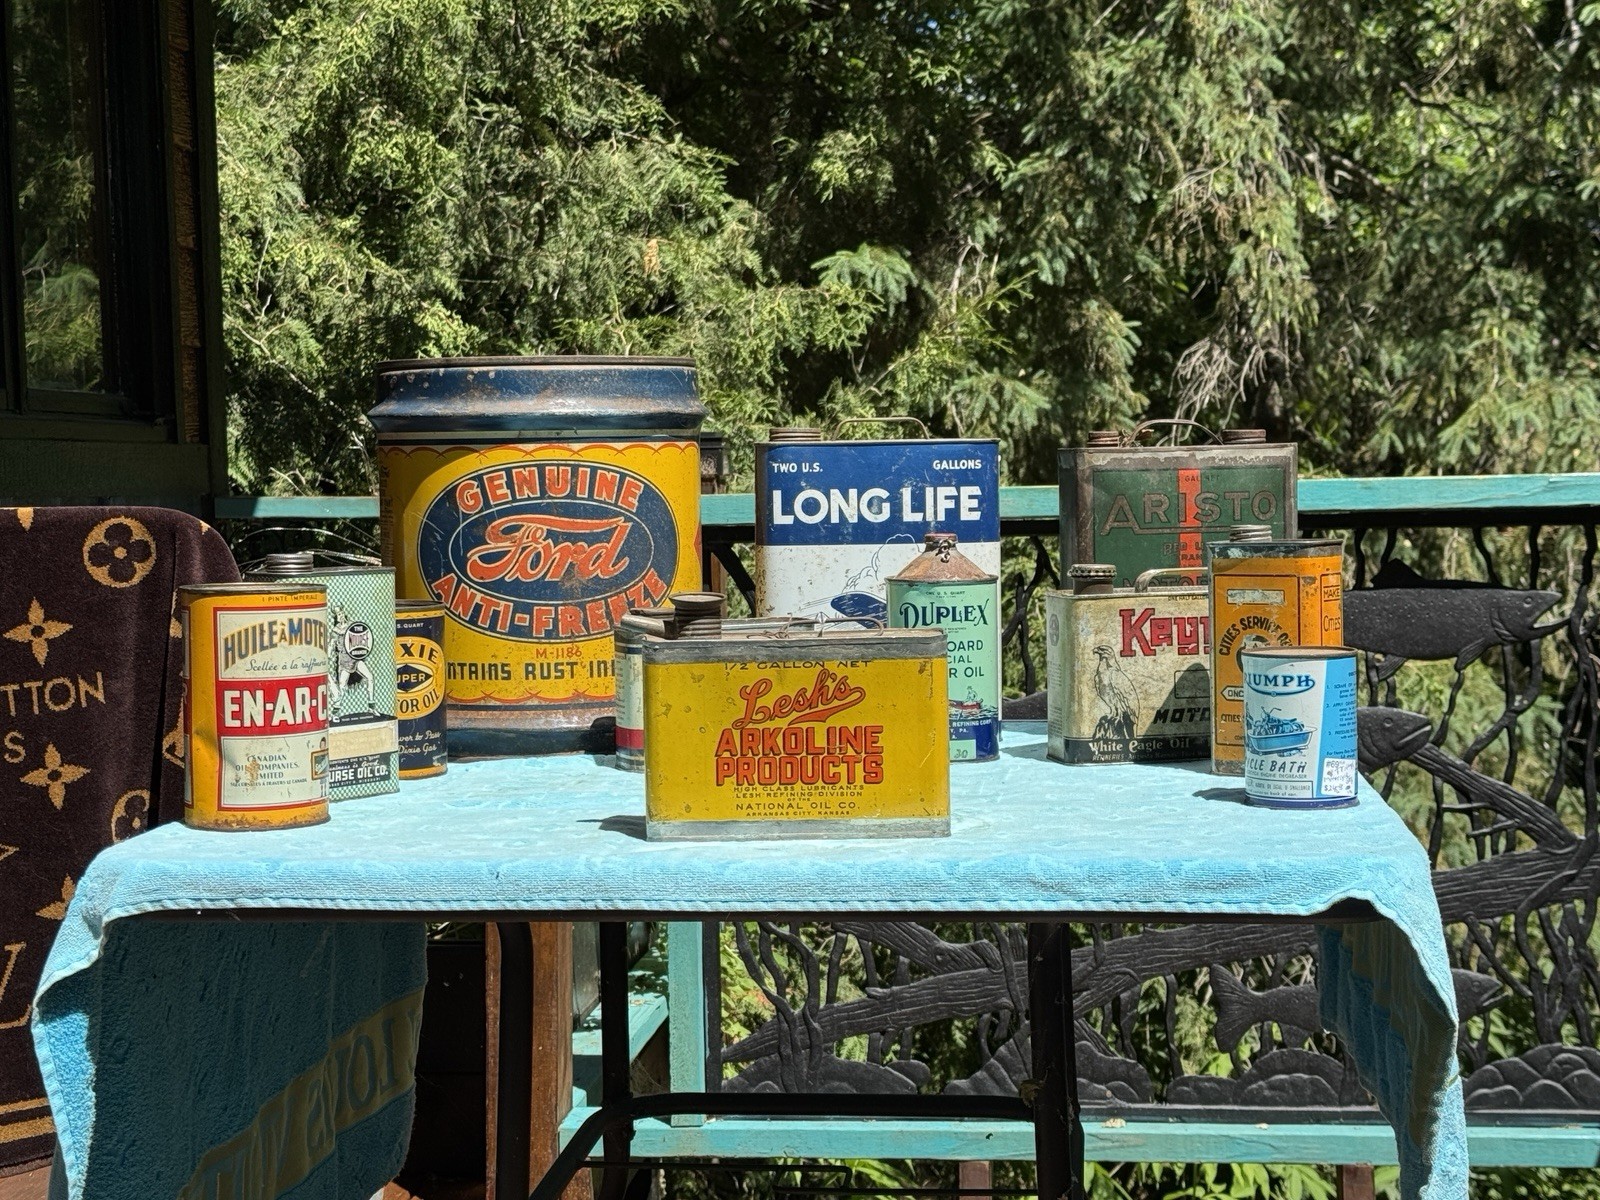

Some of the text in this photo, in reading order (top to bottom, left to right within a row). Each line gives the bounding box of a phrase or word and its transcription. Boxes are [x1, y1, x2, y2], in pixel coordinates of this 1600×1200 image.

[772, 462, 823, 473] TWO U.S.
[932, 459, 982, 470] GALLONS
[456, 465, 644, 515] GENUINE
[772, 486, 982, 525] LONG LIFE
[1100, 489, 1277, 535] ARISTO
[466, 514, 632, 583] Ford
[431, 568, 668, 637] ANTI-FREEZE
[1323, 588, 1340, 599] MAKE
[899, 598, 990, 629] DUPLEX
[224, 620, 278, 672] HUILE
[288, 617, 327, 655] MOTE
[946, 640, 984, 652] OARD
[1219, 615, 1282, 656] CITIES SERVICE
[399, 642, 438, 665] XIE
[290, 660, 298, 669] la
[447, 661, 511, 681] NTAINS
[524, 660, 577, 681] RUST
[724, 660, 872, 670] 1/2 GALLON NET
[964, 666, 985, 678] OIL
[1246, 673, 1314, 688] IUMPH
[398, 688, 440, 713] OR OIL
[731, 668, 866, 730] Lesh's
[398, 744, 421, 754] Dixie
[715, 725, 884, 758] ARKOLINE
[1089, 740, 1123, 755] White
[1169, 739, 1190, 749] Oil
[329, 769, 355, 782] URSE
[357, 766, 373, 779] OIL
[374, 764, 388, 776] CO.
[715, 754, 885, 787] PRODUCTS
[1247, 758, 1265, 770] CLE
[1269, 759, 1307, 773] BATH
[736, 802, 803, 810] NATIONAL
[838, 801, 860, 809] CO.
